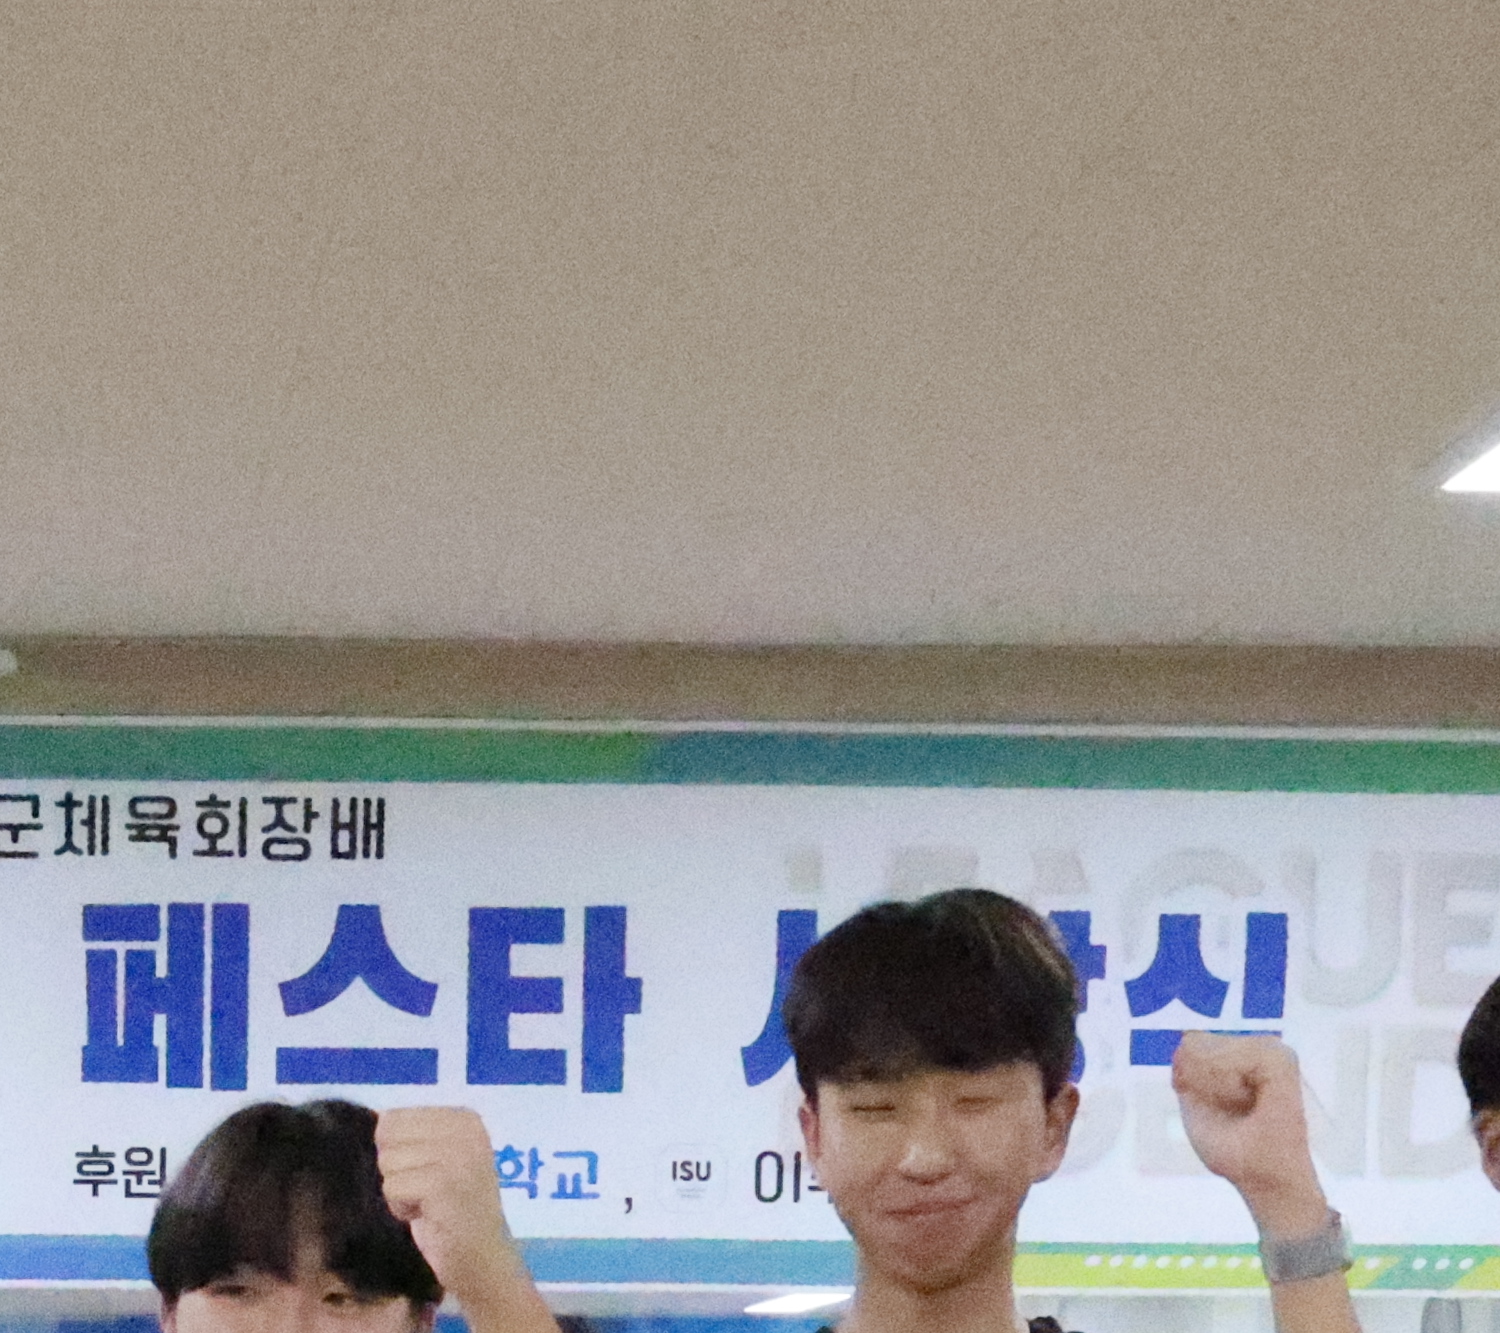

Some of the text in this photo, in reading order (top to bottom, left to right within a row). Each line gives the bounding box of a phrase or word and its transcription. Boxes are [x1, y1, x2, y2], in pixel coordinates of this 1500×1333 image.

[81, 902, 645, 1093] 페스타
[73, 1145, 166, 1199] 후원
[672, 1160, 711, 1182] ISU
